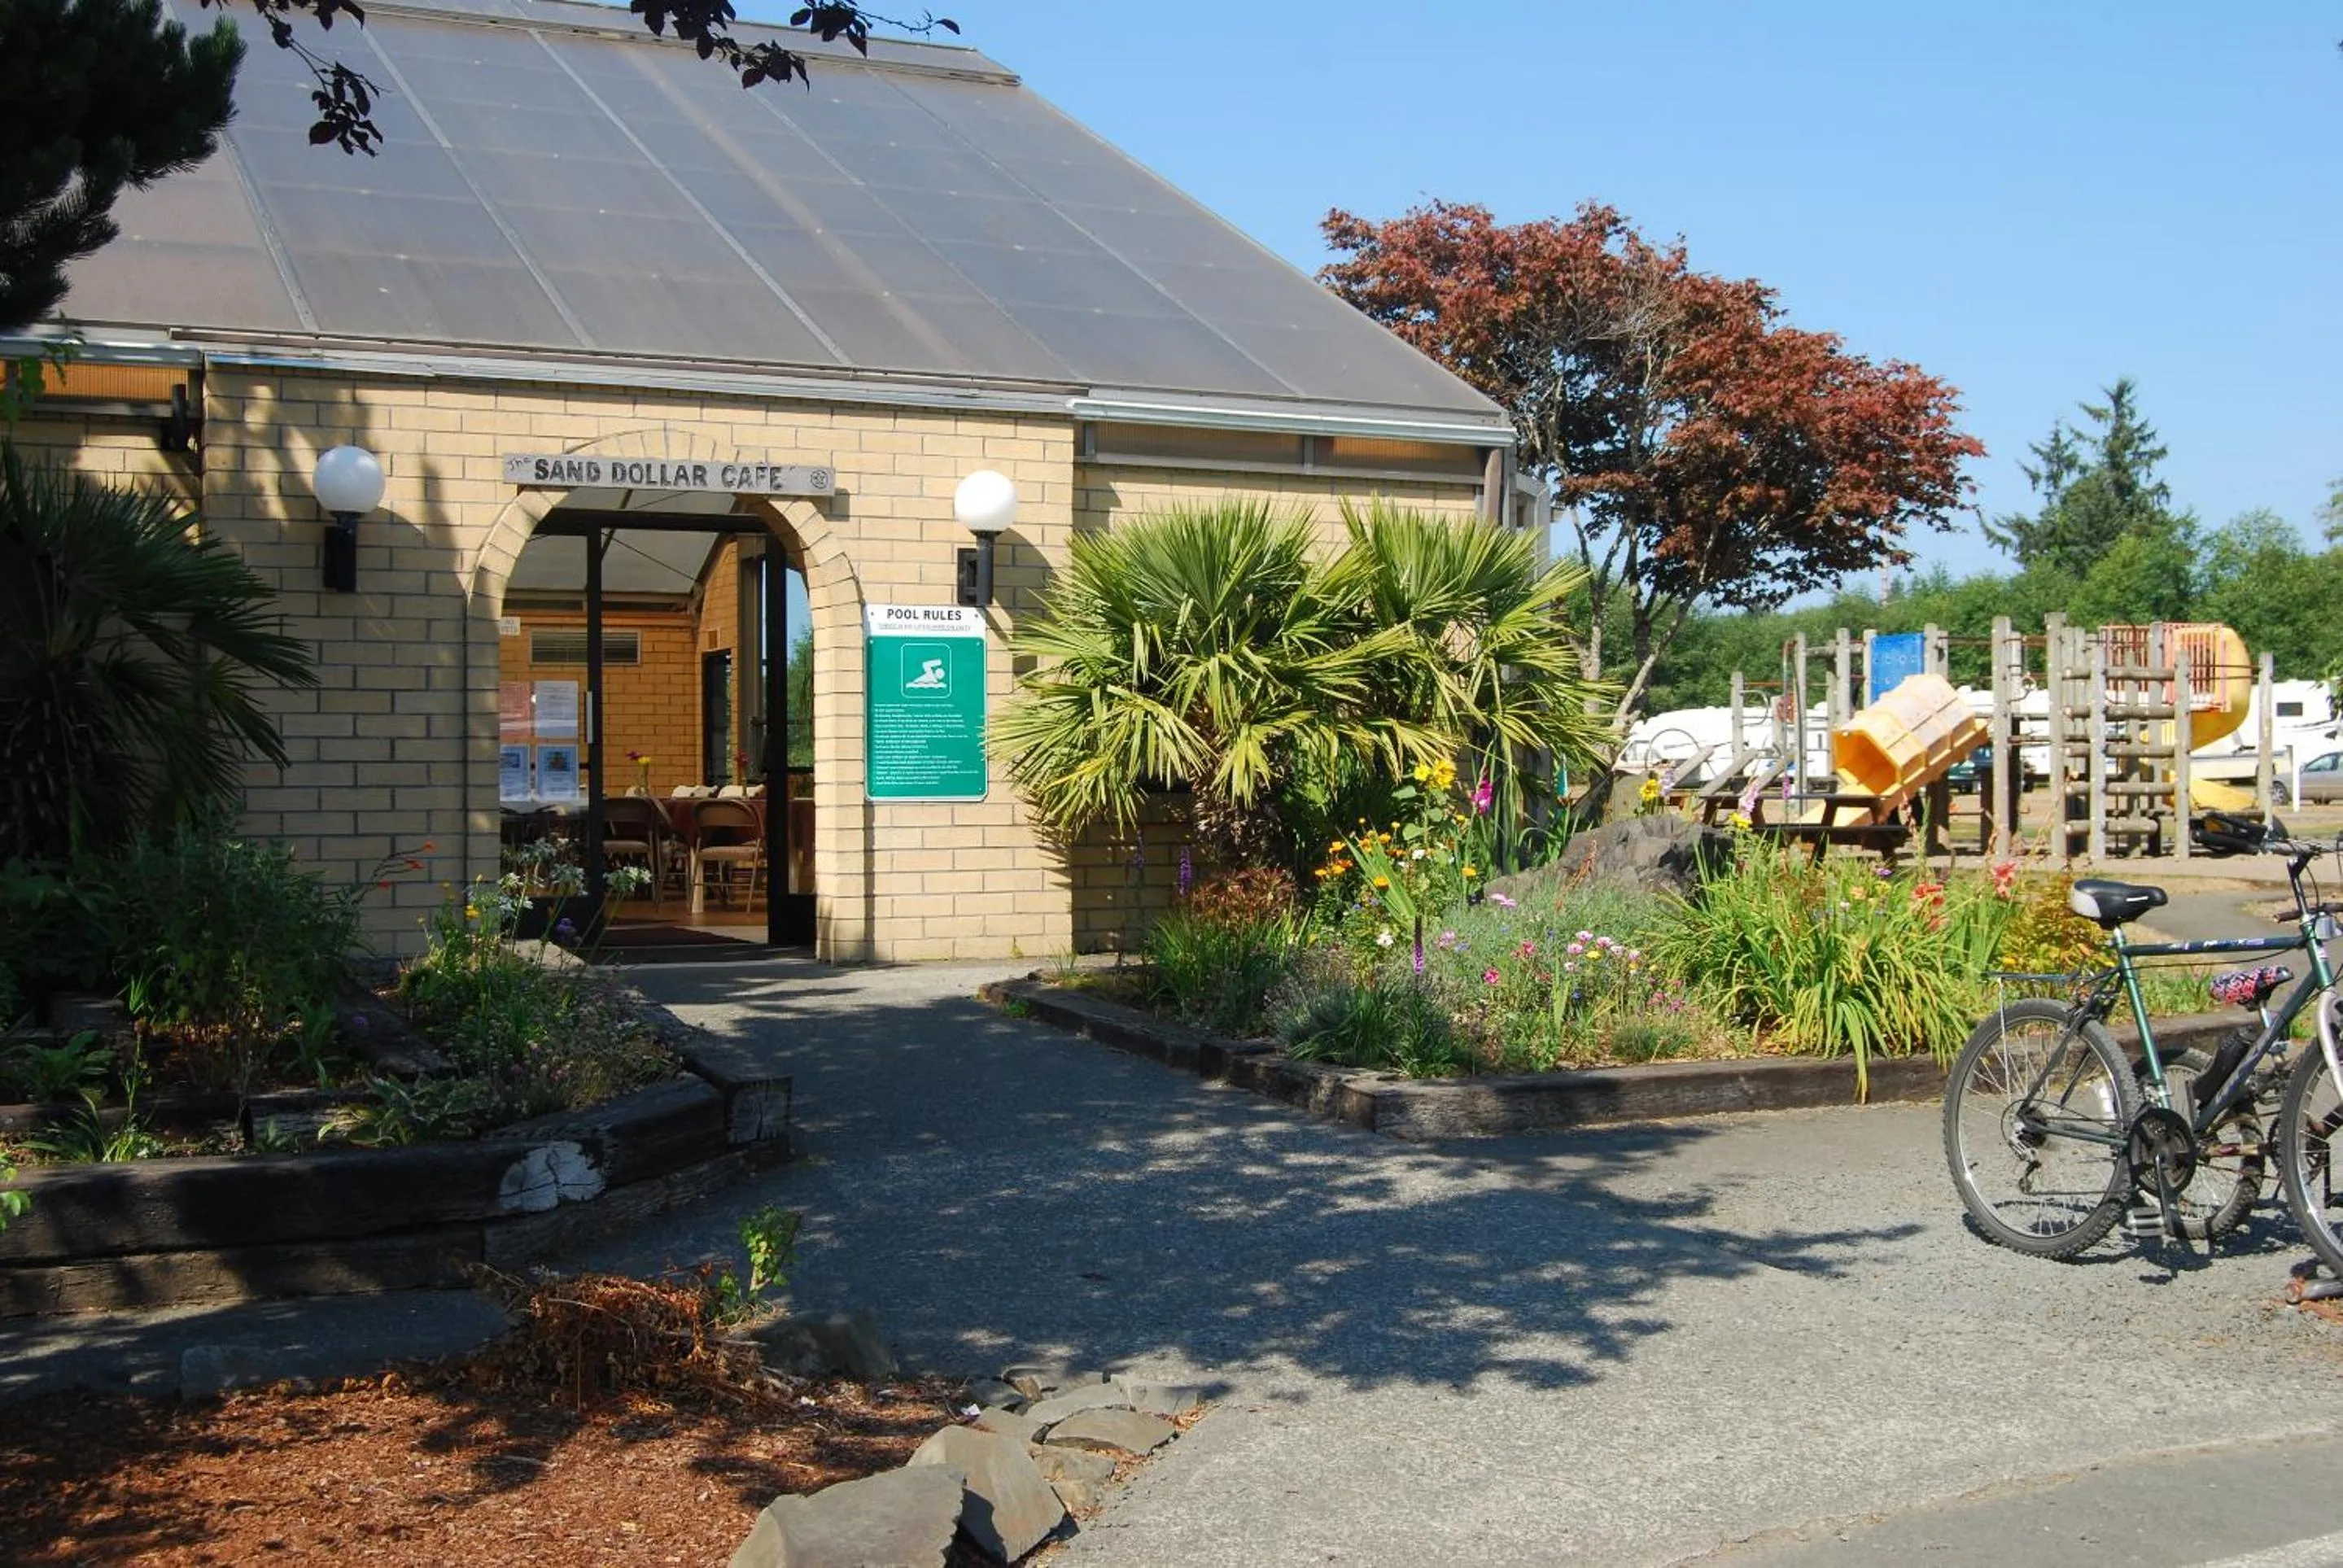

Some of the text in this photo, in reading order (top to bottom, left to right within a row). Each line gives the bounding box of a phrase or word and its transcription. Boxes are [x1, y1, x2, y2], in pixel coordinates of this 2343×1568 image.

[535, 458, 601, 483] SAND
[611, 461, 707, 487] DOLLAR
[887, 609, 962, 621] POOL RULES
